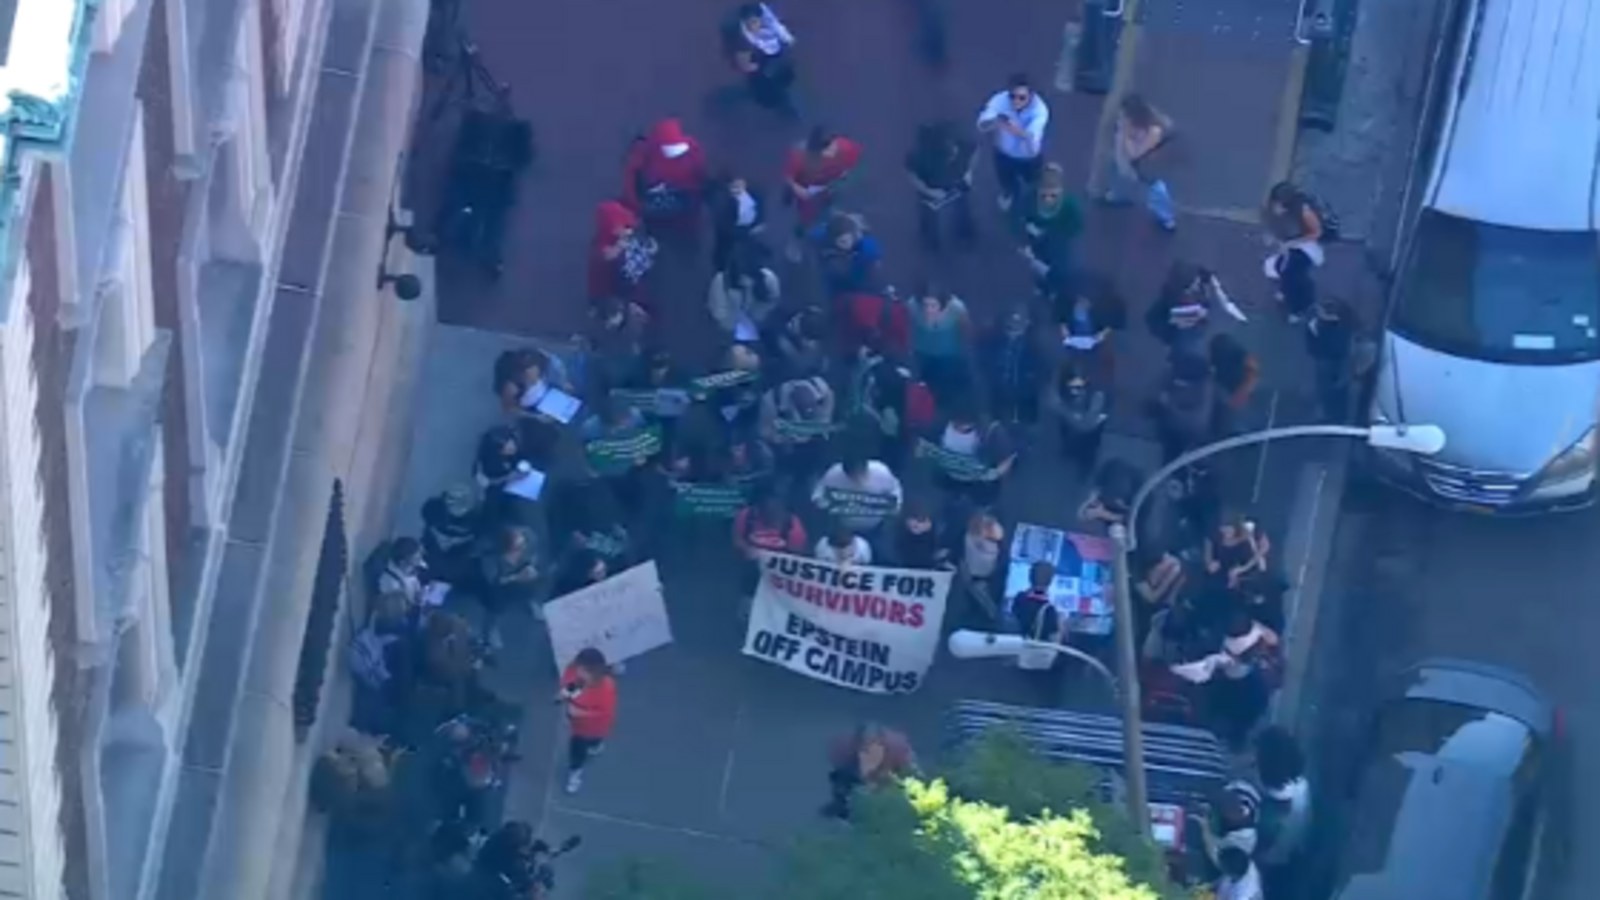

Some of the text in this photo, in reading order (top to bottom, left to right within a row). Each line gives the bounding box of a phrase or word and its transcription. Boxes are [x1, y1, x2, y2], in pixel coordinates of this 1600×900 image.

[766, 556, 935, 598] JUSTICE FOR
[770, 573, 924, 628] SURVIVORS
[753, 630, 918, 692] OFF CAMPUS
[786, 613, 891, 666] EPSTEIN
